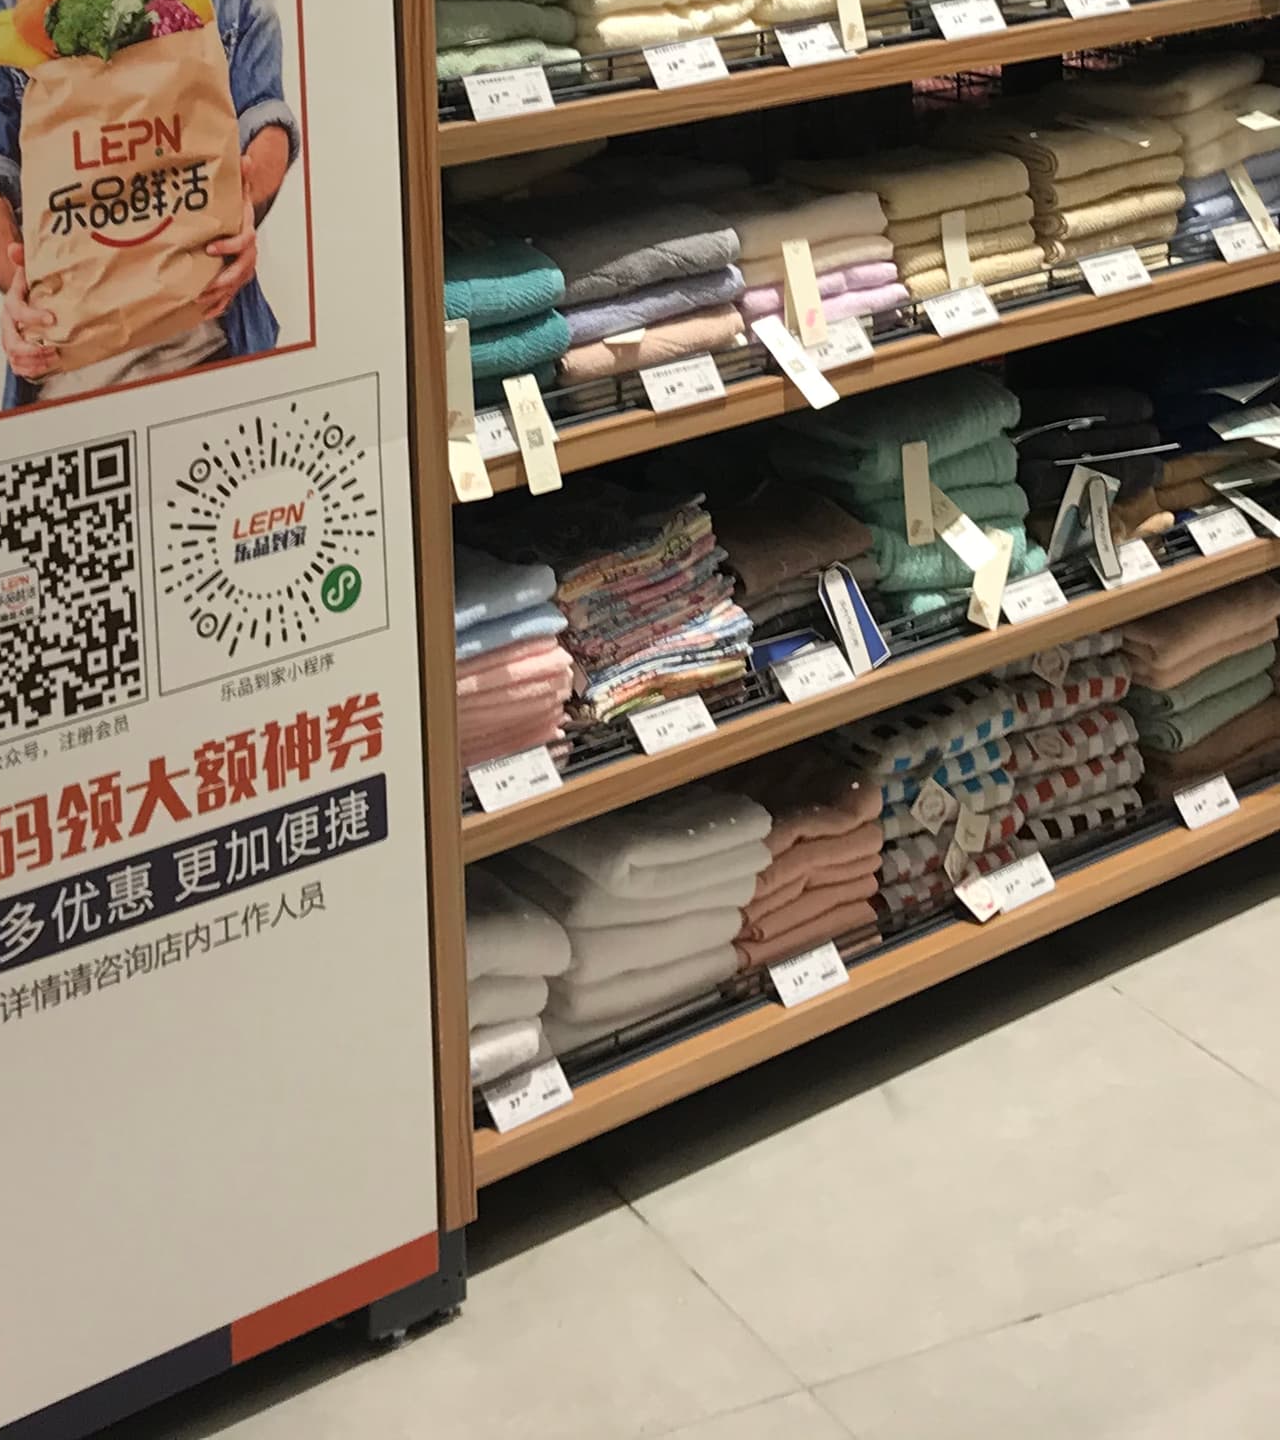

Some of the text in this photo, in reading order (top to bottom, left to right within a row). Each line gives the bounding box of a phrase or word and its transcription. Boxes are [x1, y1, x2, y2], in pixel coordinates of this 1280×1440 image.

[72, 113, 184, 172] LEPN
[49, 161, 209, 236] 乐品鲜活
[231, 501, 307, 540] LEPN
[220, 652, 336, 703] 乐品到家小程序
[172, 789, 371, 901] 更加便捷
[0, 882, 326, 1023] 详情请咨询店内工作人员
